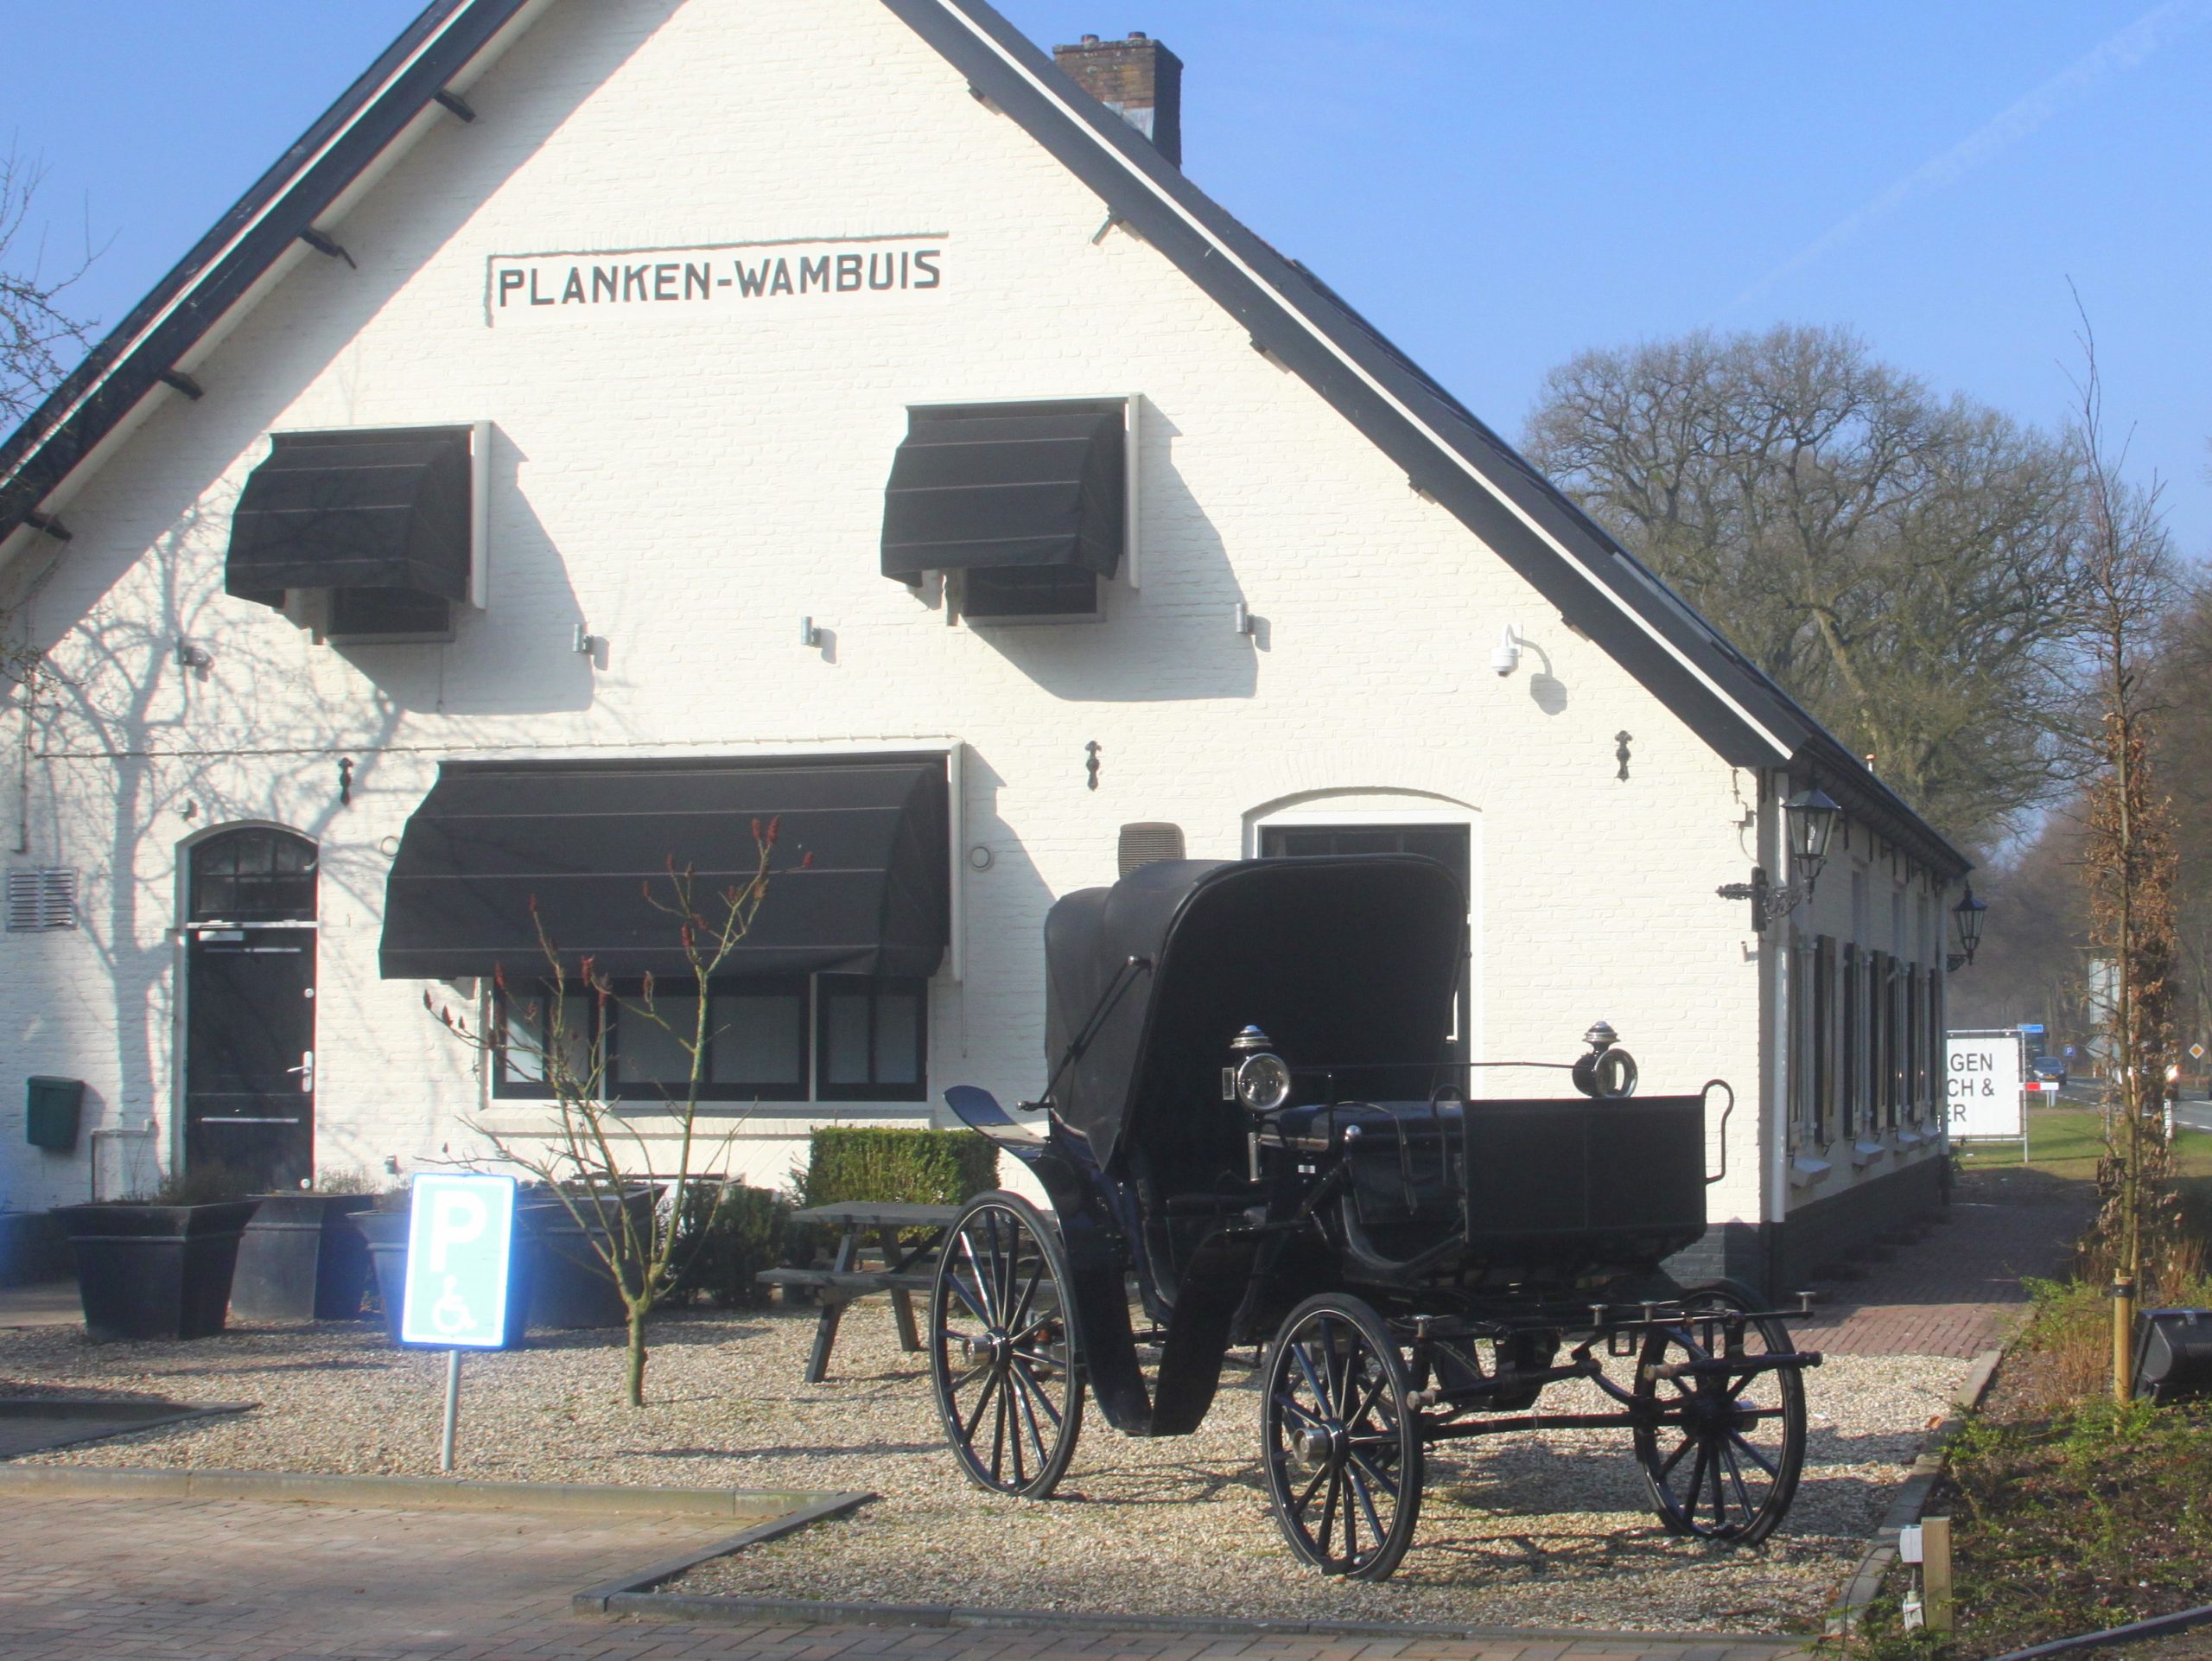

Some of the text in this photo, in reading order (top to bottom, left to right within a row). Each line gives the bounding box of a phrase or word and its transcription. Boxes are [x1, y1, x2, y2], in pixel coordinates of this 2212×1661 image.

[499, 250, 941, 307] PLANKEN-WAMBUIS
[1948, 1053, 1993, 1072] GEN
[1981, 1078, 1995, 1097] &
[430, 1191, 487, 1272] P
